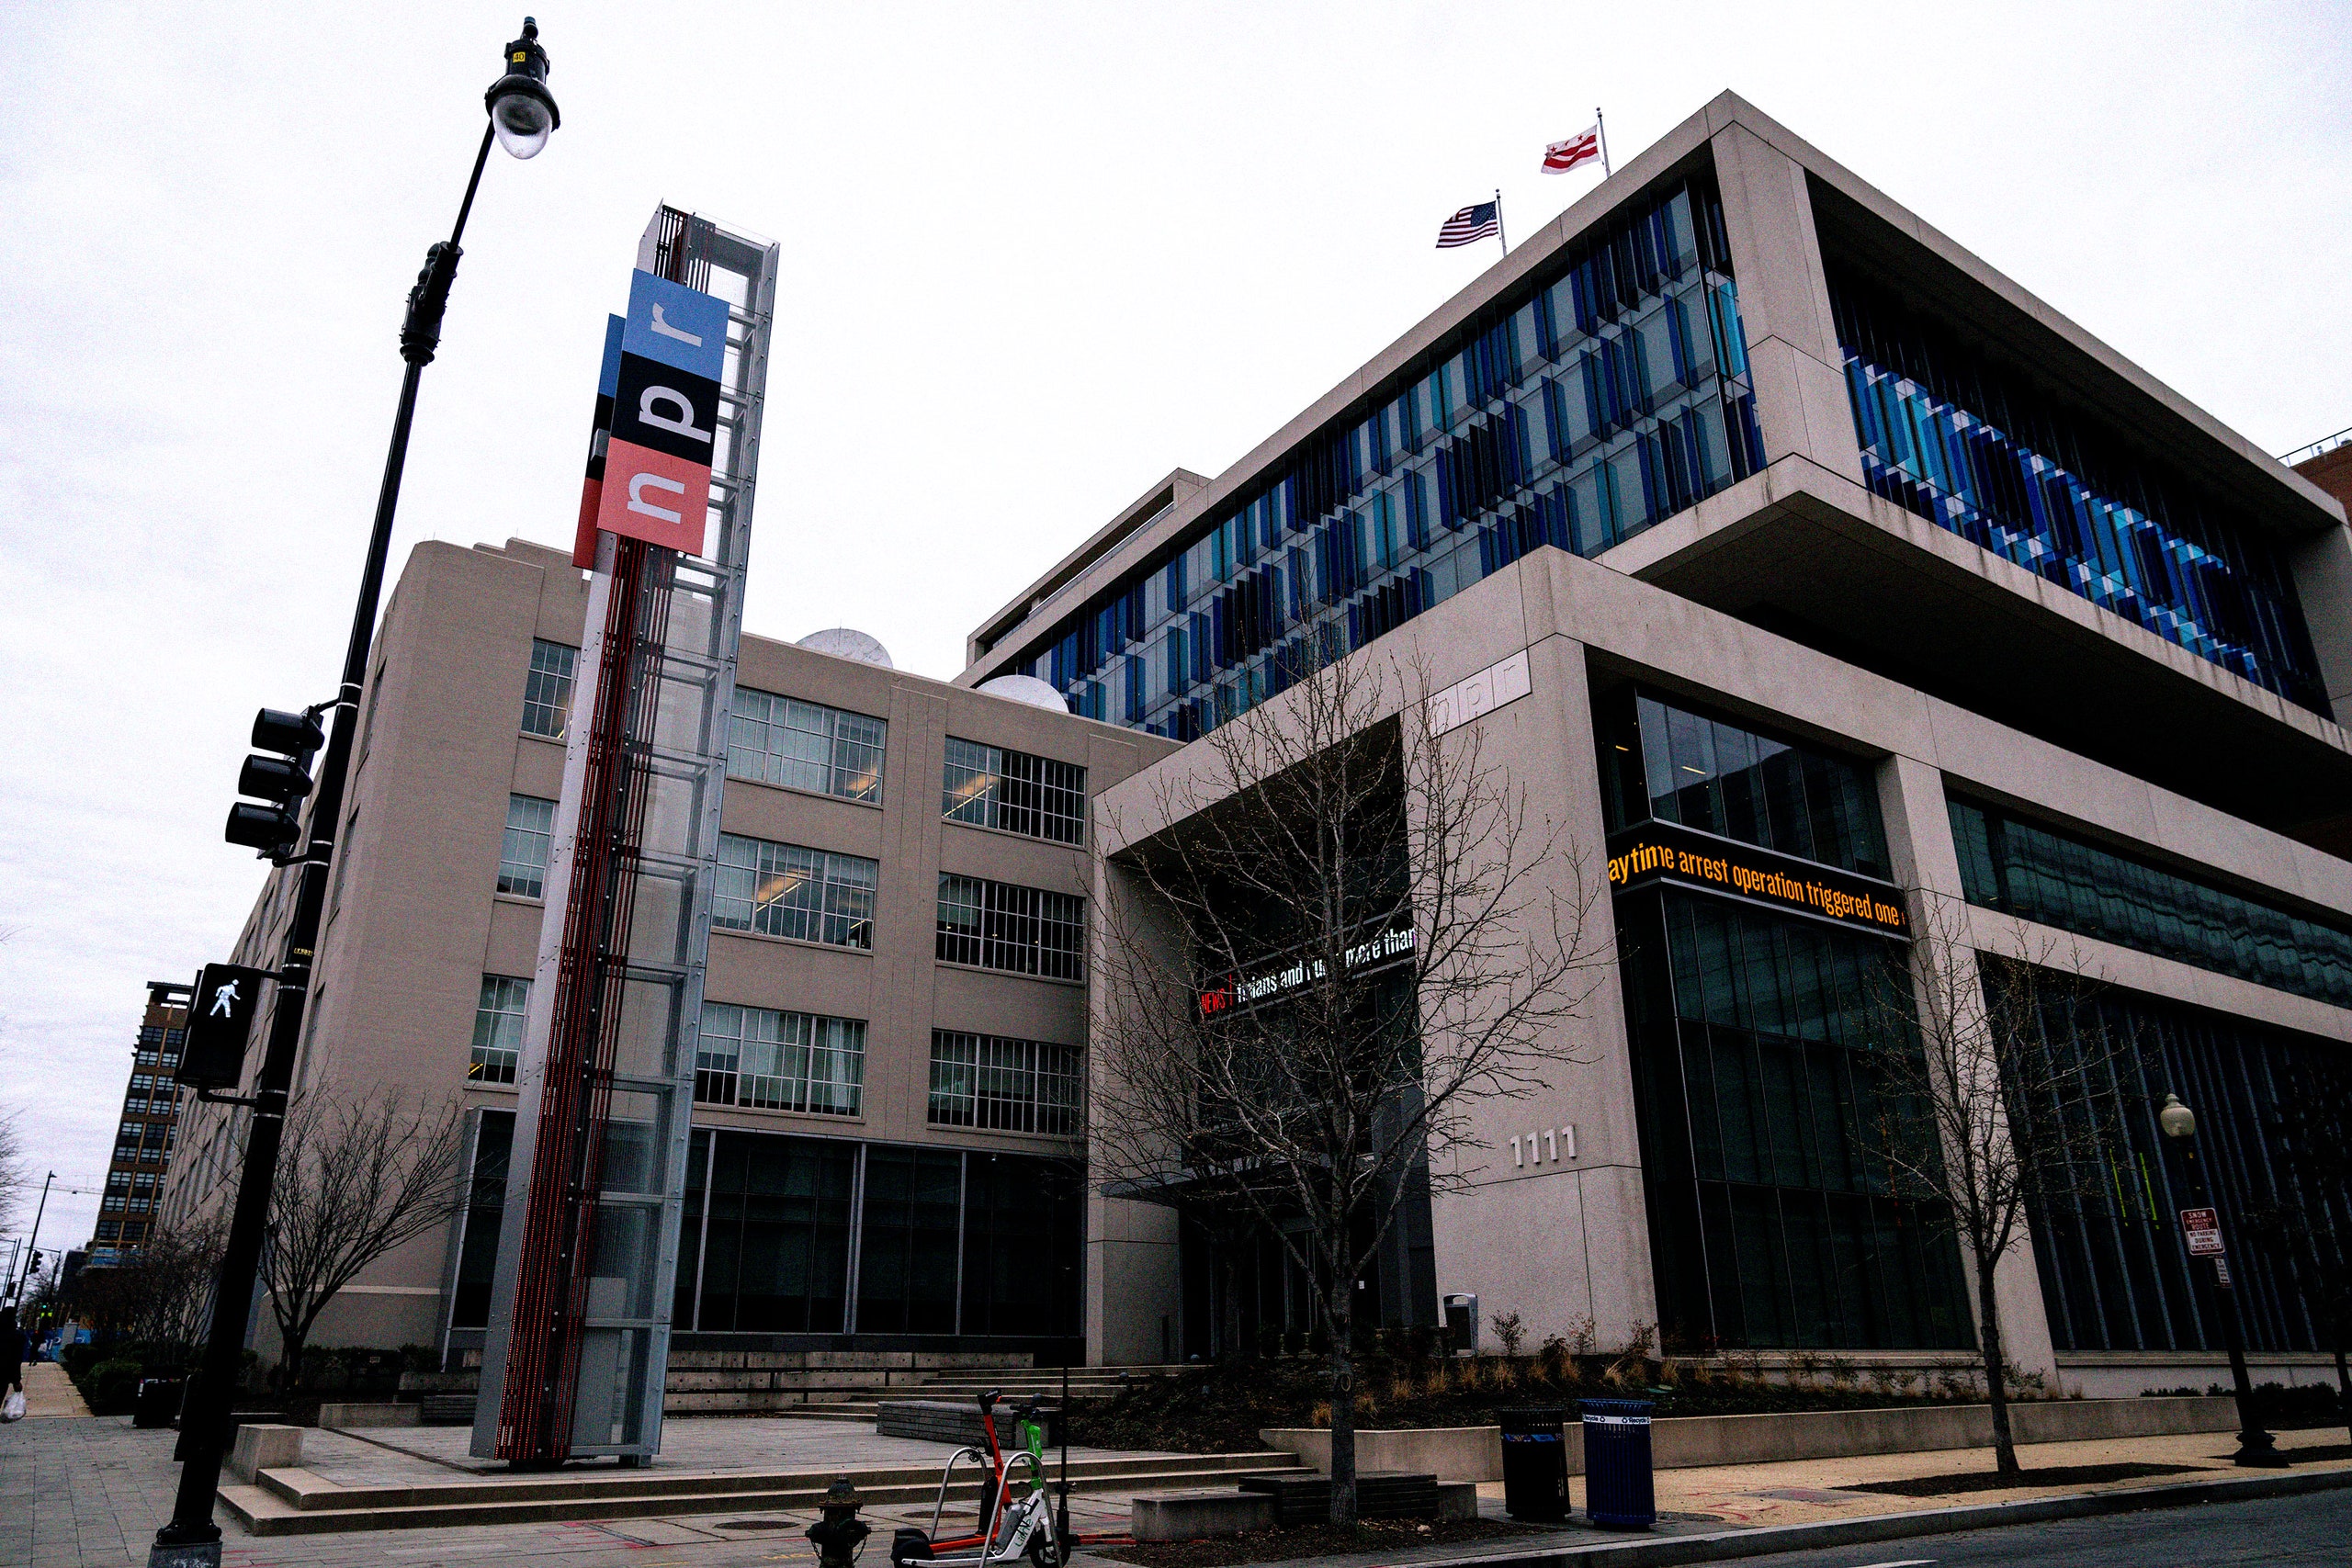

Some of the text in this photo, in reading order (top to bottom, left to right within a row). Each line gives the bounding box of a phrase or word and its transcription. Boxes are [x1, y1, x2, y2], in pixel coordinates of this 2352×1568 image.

[514, 52, 525, 61] 40
[627, 301, 711, 525] npr
[1608, 842, 1899, 926] aytime arrest operation triggered one
[1201, 987, 1226, 1014] NEWS
[1280, 960, 1304, 987] and
[1345, 940, 1381, 968] more
[1510, 1125, 1577, 1168] 1111
